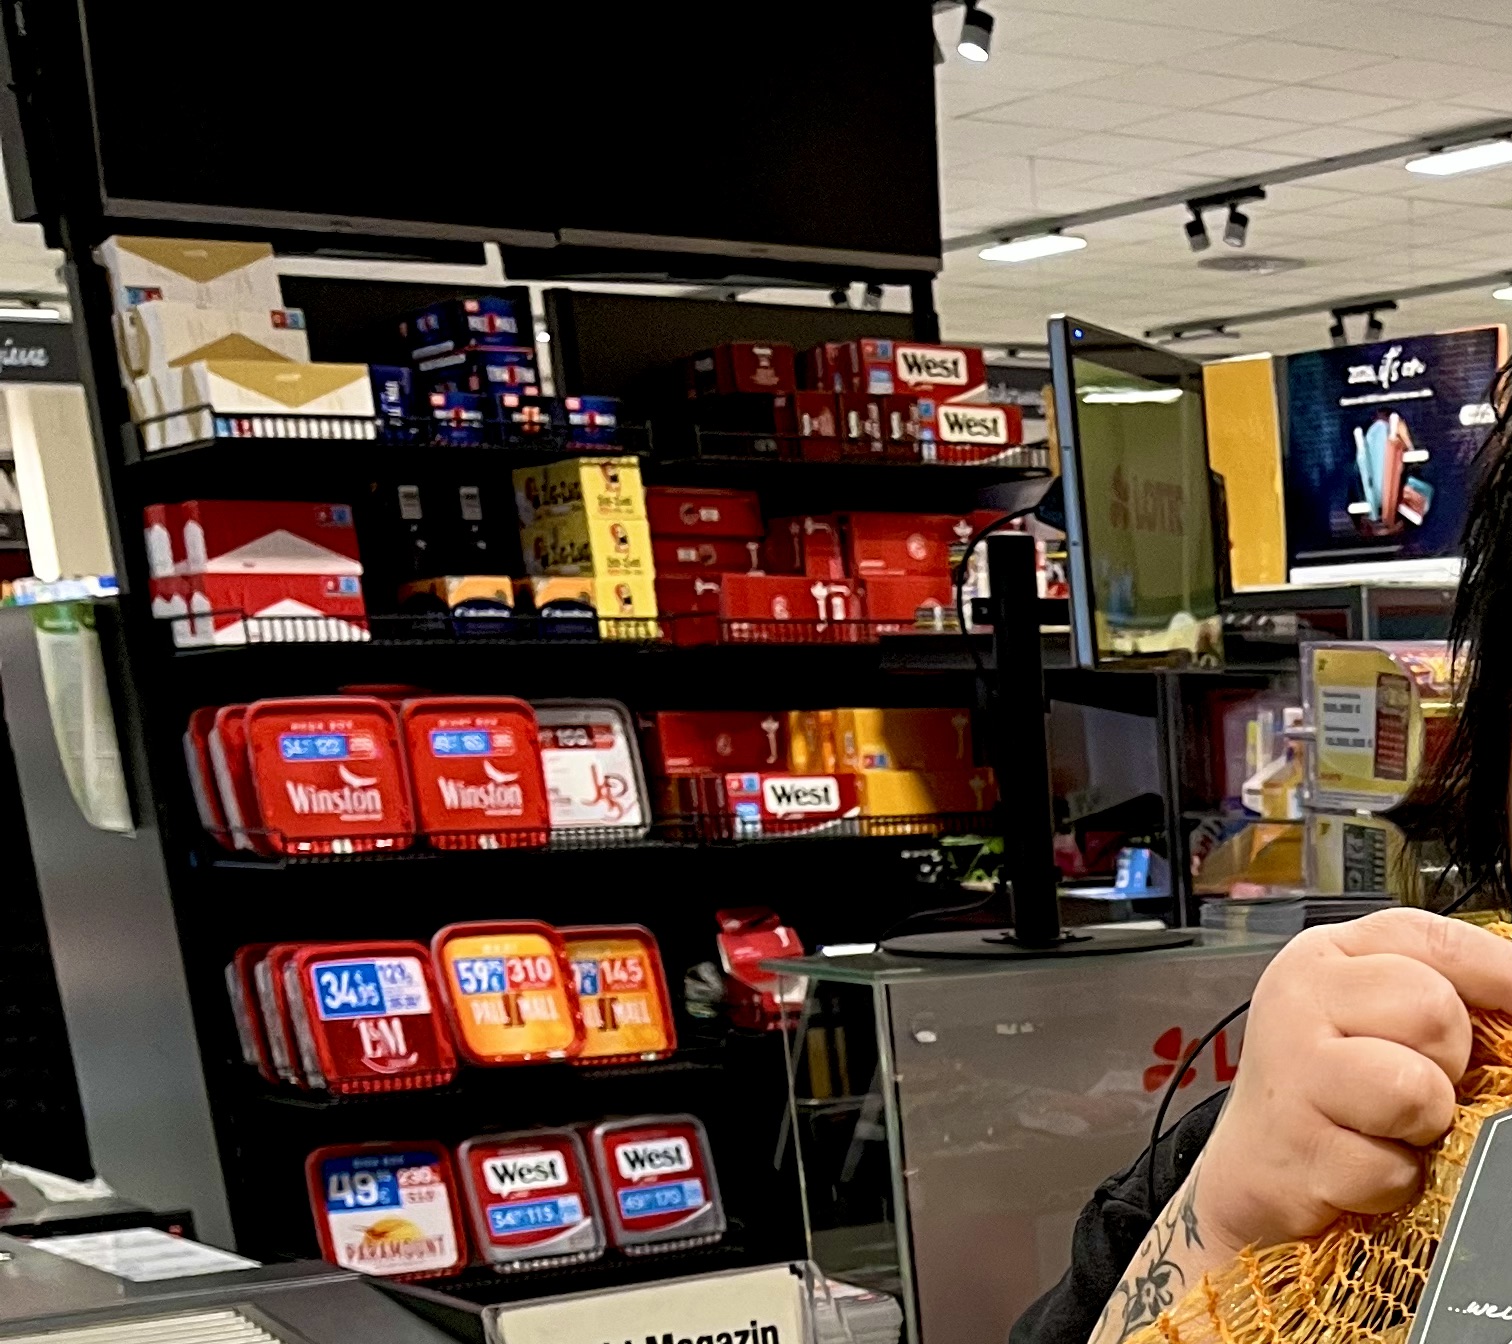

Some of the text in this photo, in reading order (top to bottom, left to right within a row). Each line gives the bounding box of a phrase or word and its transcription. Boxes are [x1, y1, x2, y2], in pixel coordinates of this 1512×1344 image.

[902, 352, 961, 379] West
[943, 411, 1000, 438] West
[286, 780, 382, 815] Winston
[437, 776, 524, 810] Winston
[770, 783, 832, 807] West
[507, 956, 552, 984] 310
[601, 958, 643, 985] 145
[623, 1143, 685, 1172] West
[491, 1158, 558, 1187] West
